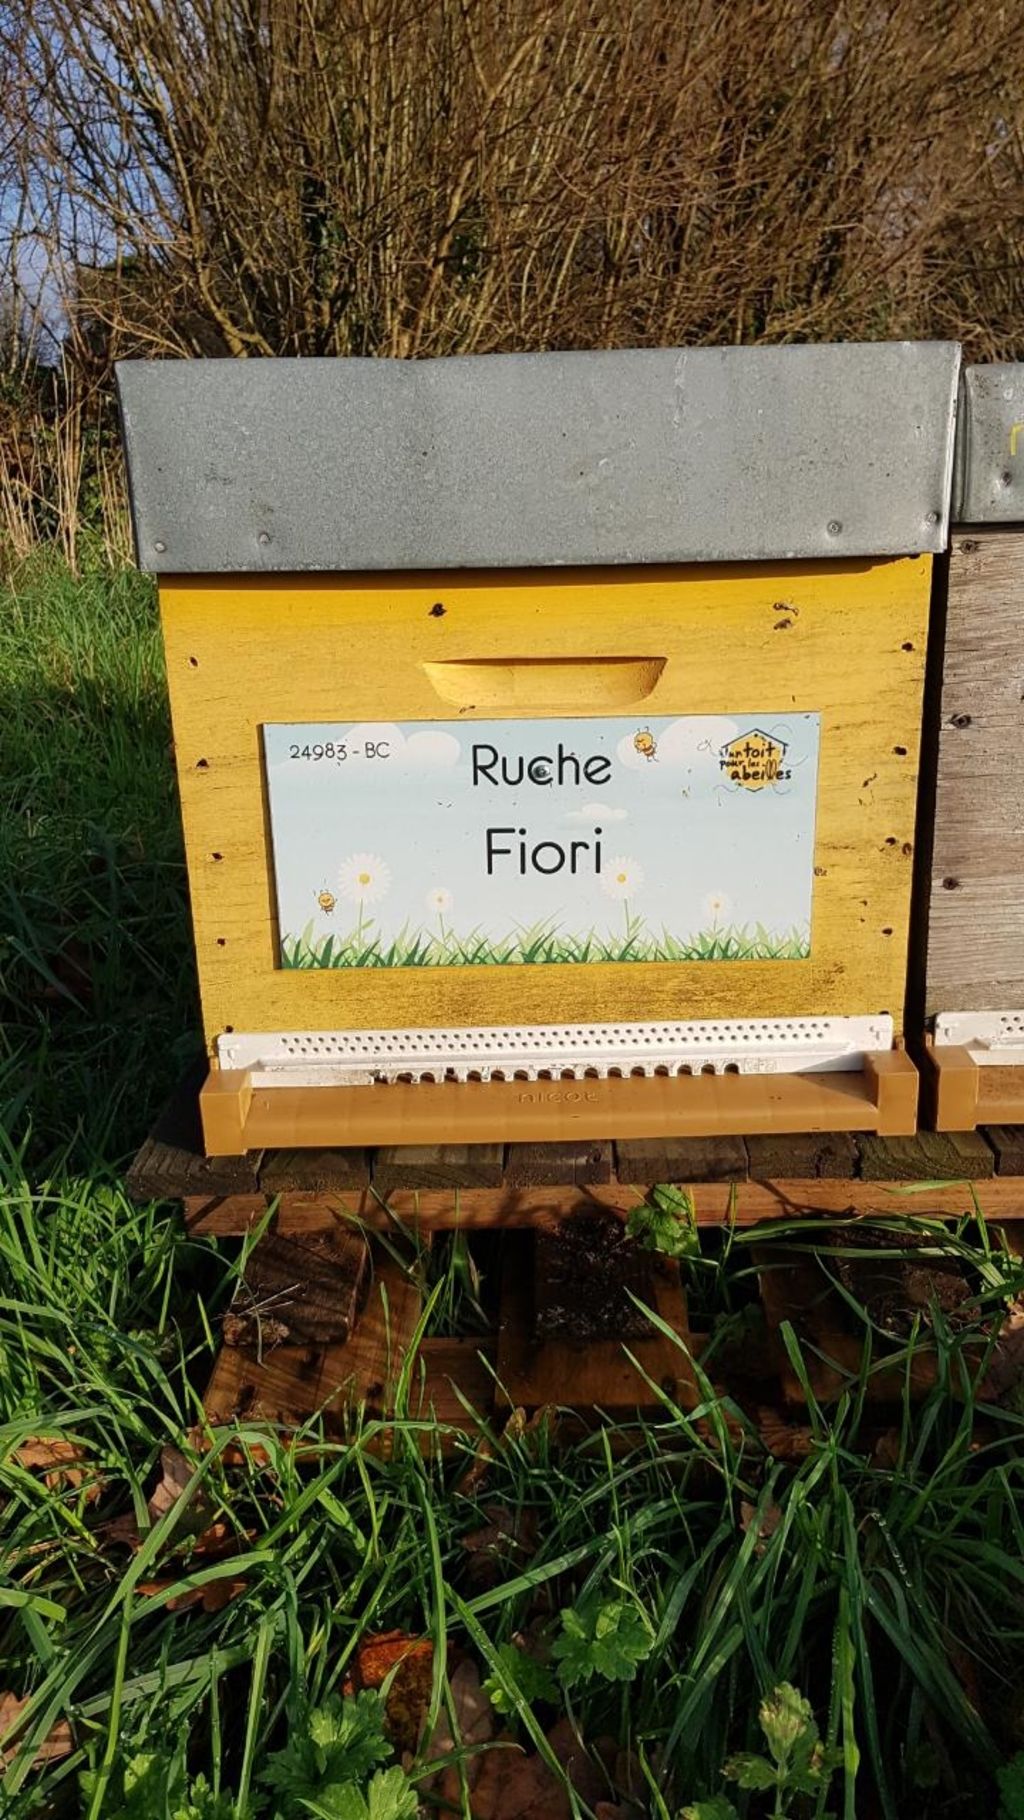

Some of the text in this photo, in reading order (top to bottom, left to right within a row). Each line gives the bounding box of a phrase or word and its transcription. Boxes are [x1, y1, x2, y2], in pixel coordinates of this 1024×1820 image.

[289, 742, 347, 761] 24983
[365, 741, 390, 759] BC
[743, 741, 776, 758] toit
[472, 743, 612, 786] Ruche
[719, 760, 744, 770] pour
[730, 759, 792, 781] abeilles
[486, 827, 603, 875] Fiori
